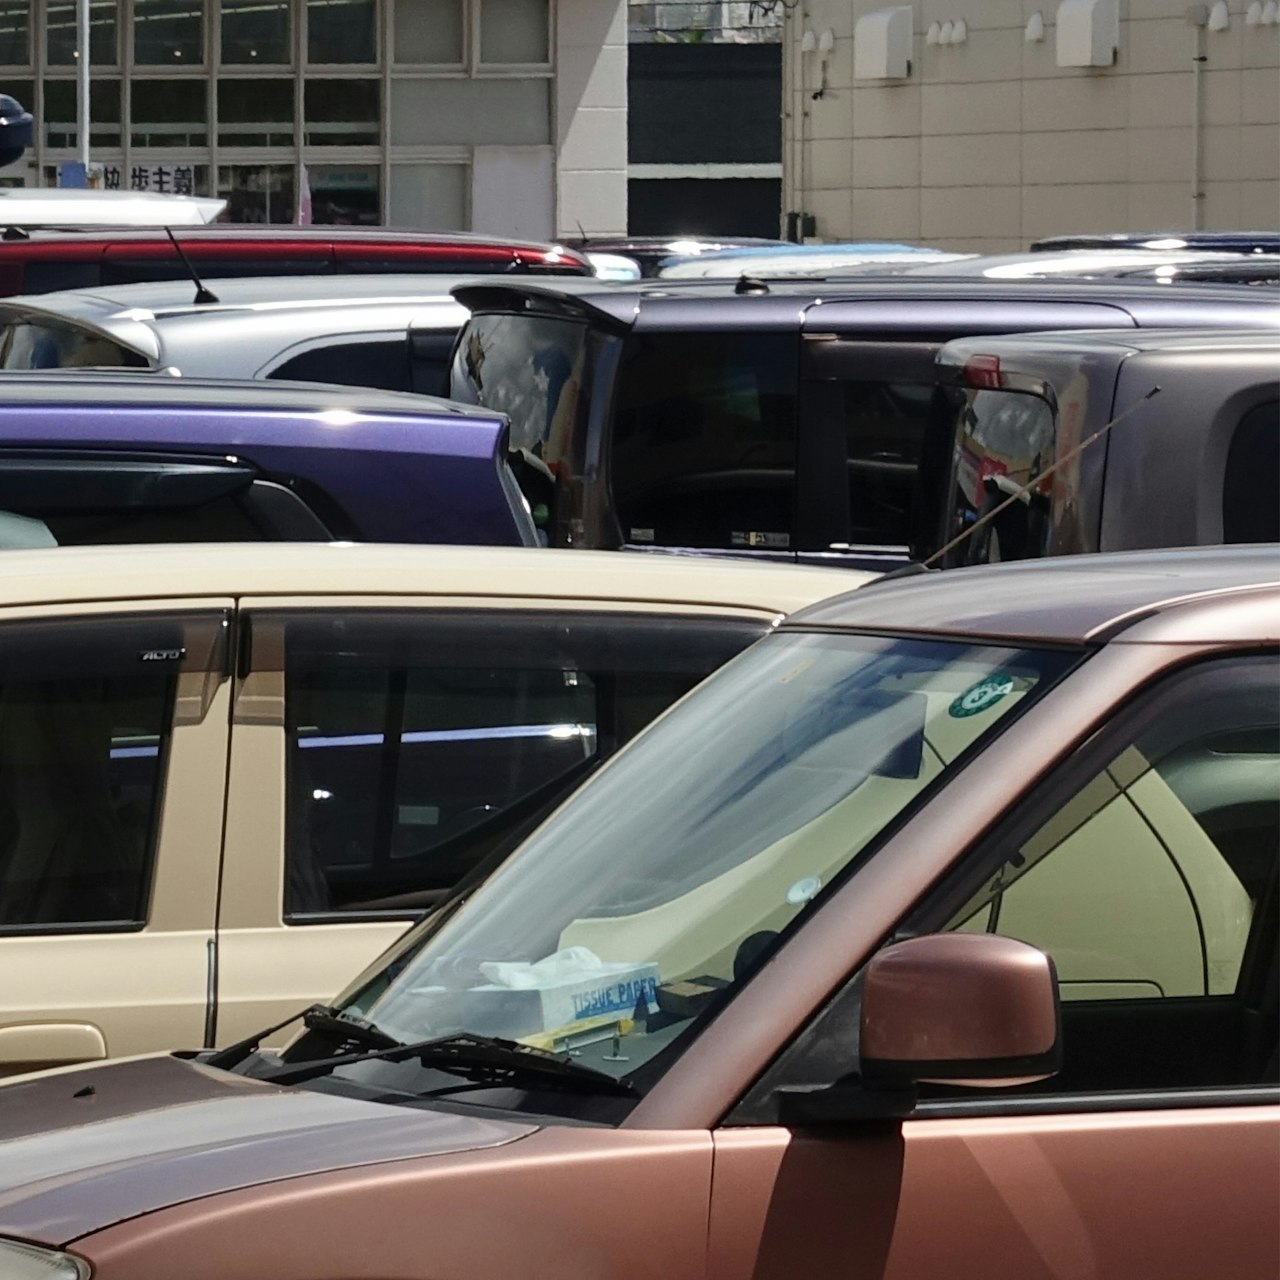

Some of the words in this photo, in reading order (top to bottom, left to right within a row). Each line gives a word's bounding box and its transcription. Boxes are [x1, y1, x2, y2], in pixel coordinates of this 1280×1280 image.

[142, 650, 180, 661] ALTO
[571, 986, 614, 1012] TISSUE
[618, 976, 657, 1004] PAPER
